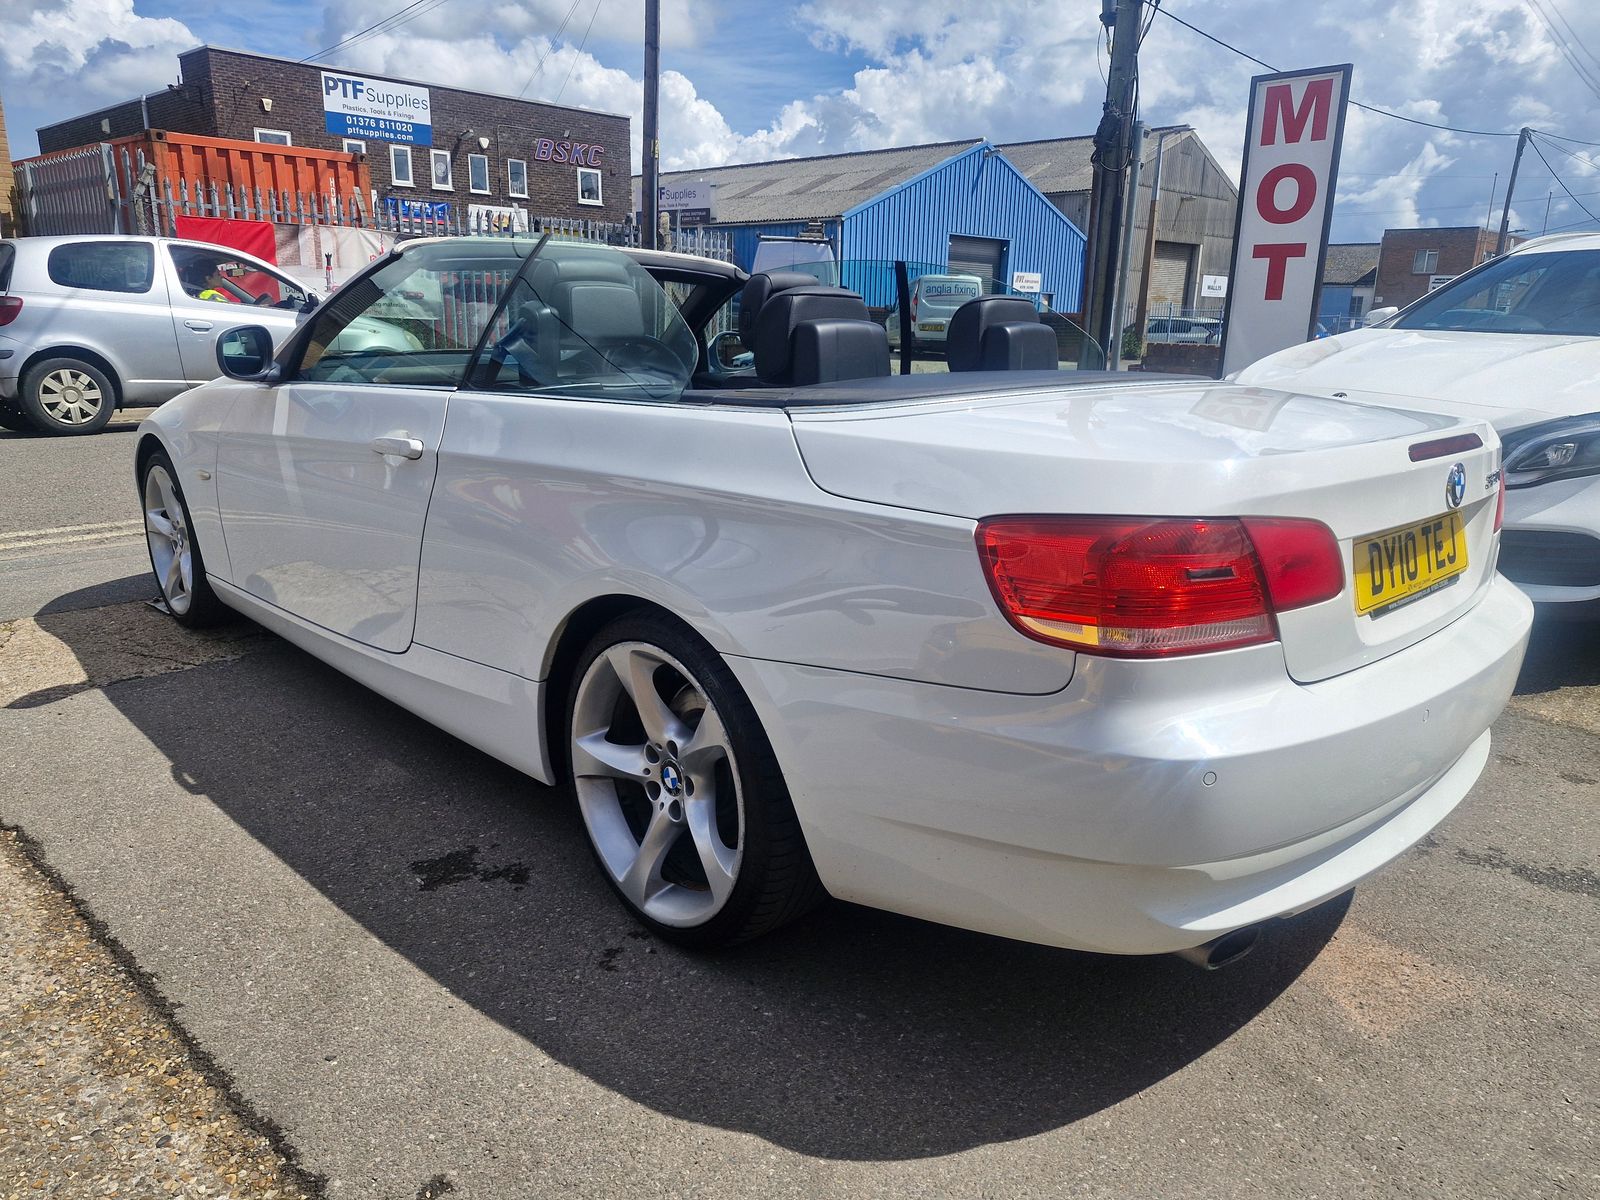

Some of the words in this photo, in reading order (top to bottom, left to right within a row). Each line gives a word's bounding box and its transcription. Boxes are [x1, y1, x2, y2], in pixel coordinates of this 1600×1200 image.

[323, 76, 364, 100] PTF
[366, 88, 428, 110] Supplies
[342, 103, 369, 114] Plastics,
[370, 108, 386, 116] Tools
[393, 111, 415, 120] Fixings
[346, 115, 376, 128] 01376
[379, 119, 413, 132] 811020
[347, 126, 414, 141] ptfsupplies.com
[534, 138, 605, 166] BSKC
[665, 188, 697, 201] Supplies
[1252, 79, 1333, 301] MOT
[925, 284, 952, 295] anglia
[954, 284, 977, 298] fixing
[1368, 531, 1418, 597] DY10
[1421, 517, 1457, 574] TEJ
